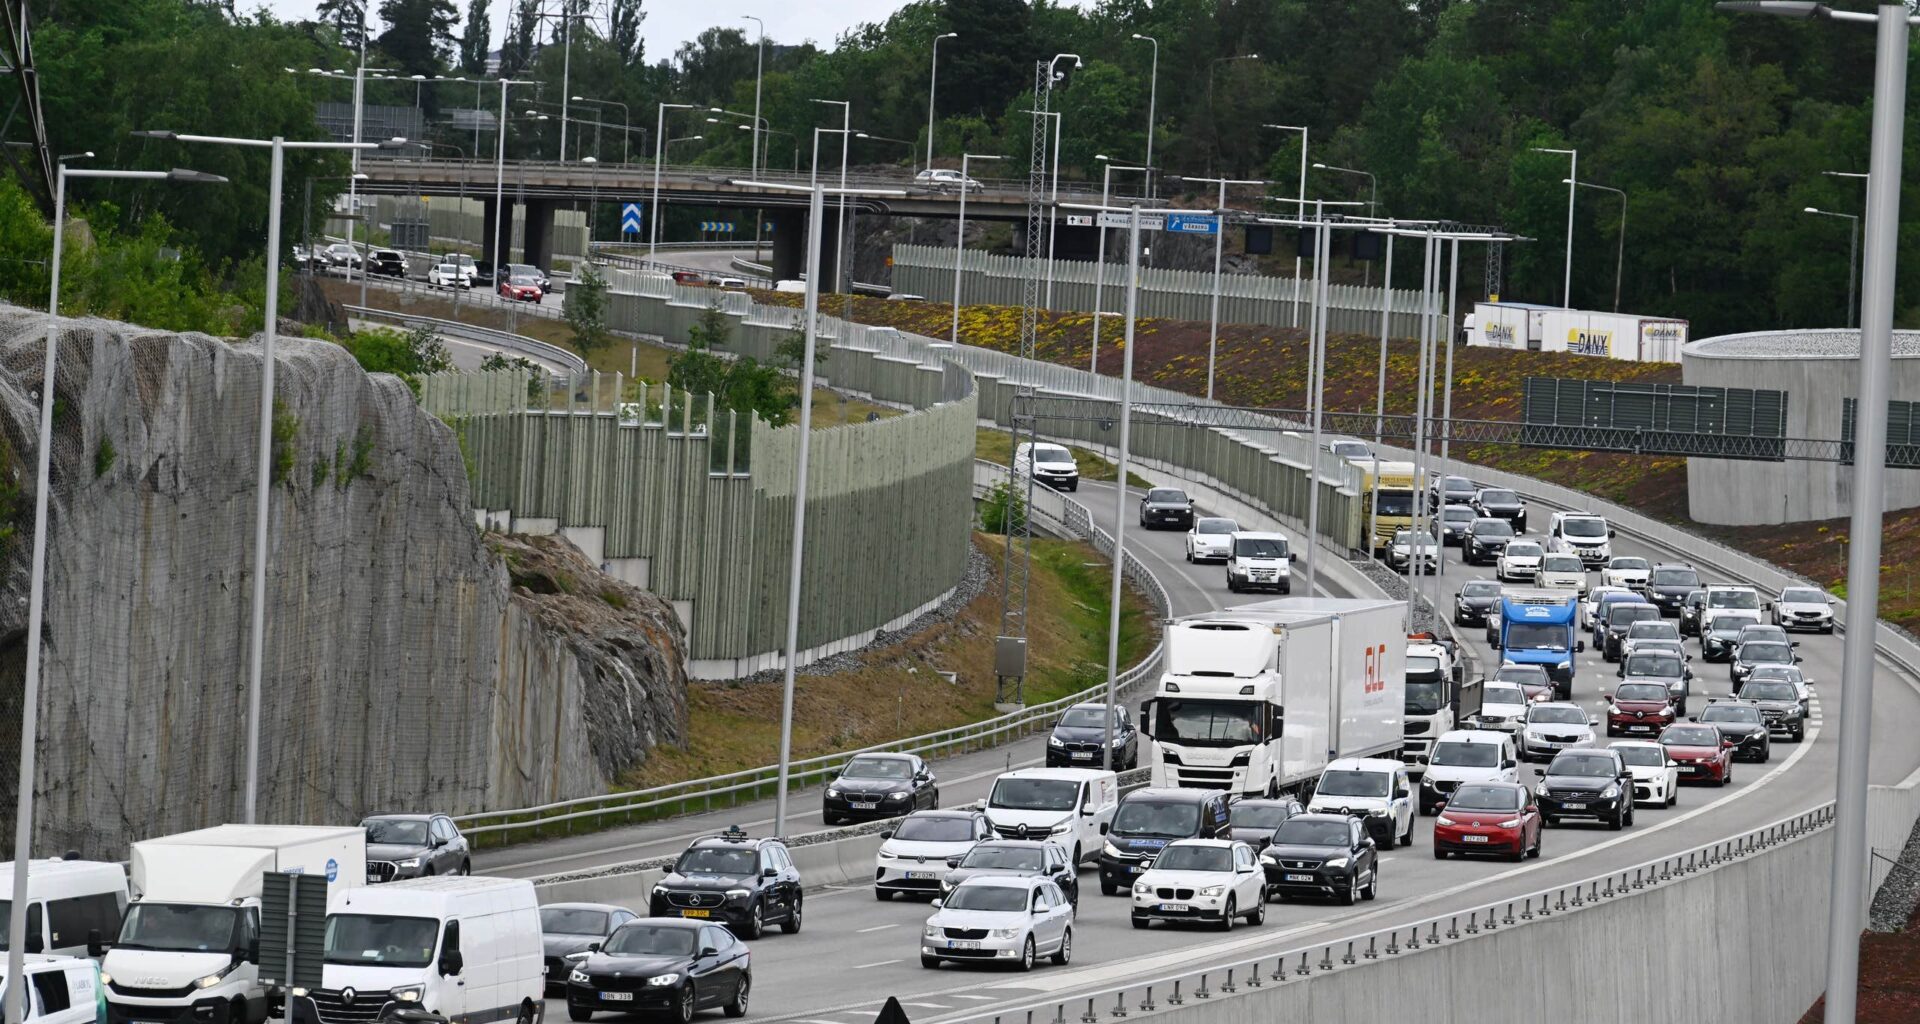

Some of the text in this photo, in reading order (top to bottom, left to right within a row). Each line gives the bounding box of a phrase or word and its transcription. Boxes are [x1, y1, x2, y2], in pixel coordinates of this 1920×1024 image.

[1492, 324, 1513, 339] DANX
[1652, 328, 1678, 337] DANX
[1577, 332, 1608, 356] DANX
[1365, 644, 1385, 694] GLC
[134, 976, 169, 985] IVECO
